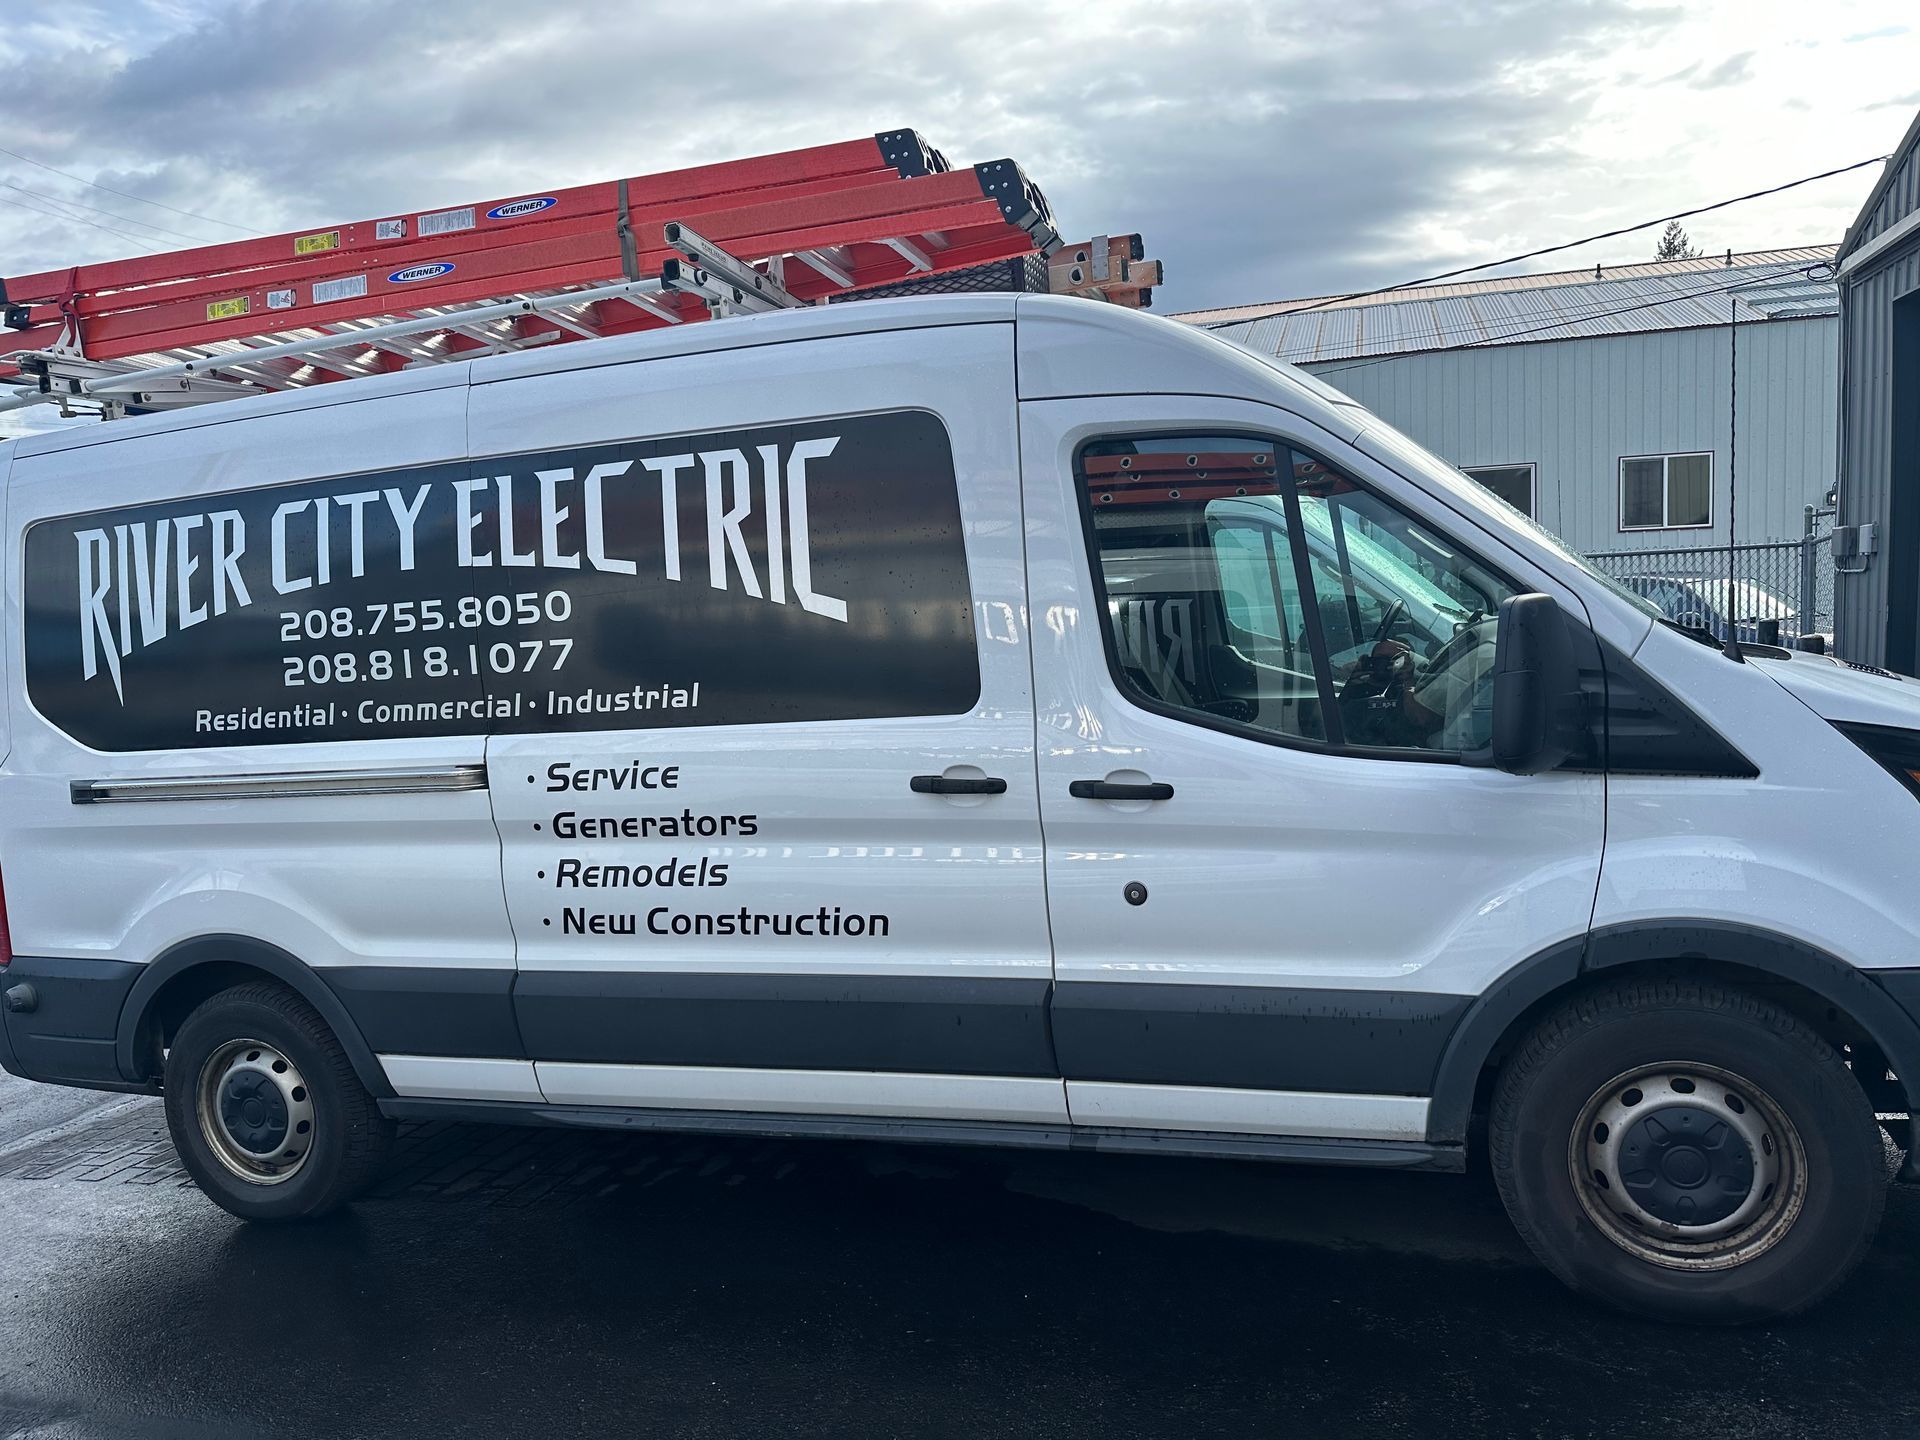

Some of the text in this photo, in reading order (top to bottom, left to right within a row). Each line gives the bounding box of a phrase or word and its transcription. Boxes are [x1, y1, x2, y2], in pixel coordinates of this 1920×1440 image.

[502, 201, 543, 215] WERNER
[402, 266, 442, 279] WERNER
[74, 436, 848, 707] RIVER CITY ELECTRIC
[280, 590, 573, 642] 208.755.8050
[283, 638, 574, 687] 208.818.1077
[195, 682, 700, 733] Residential Commercial Industrial
[546, 760, 680, 793] Service
[552, 808, 758, 839] Generators
[556, 857, 729, 888] Remodels
[562, 906, 889, 937] New Construction
